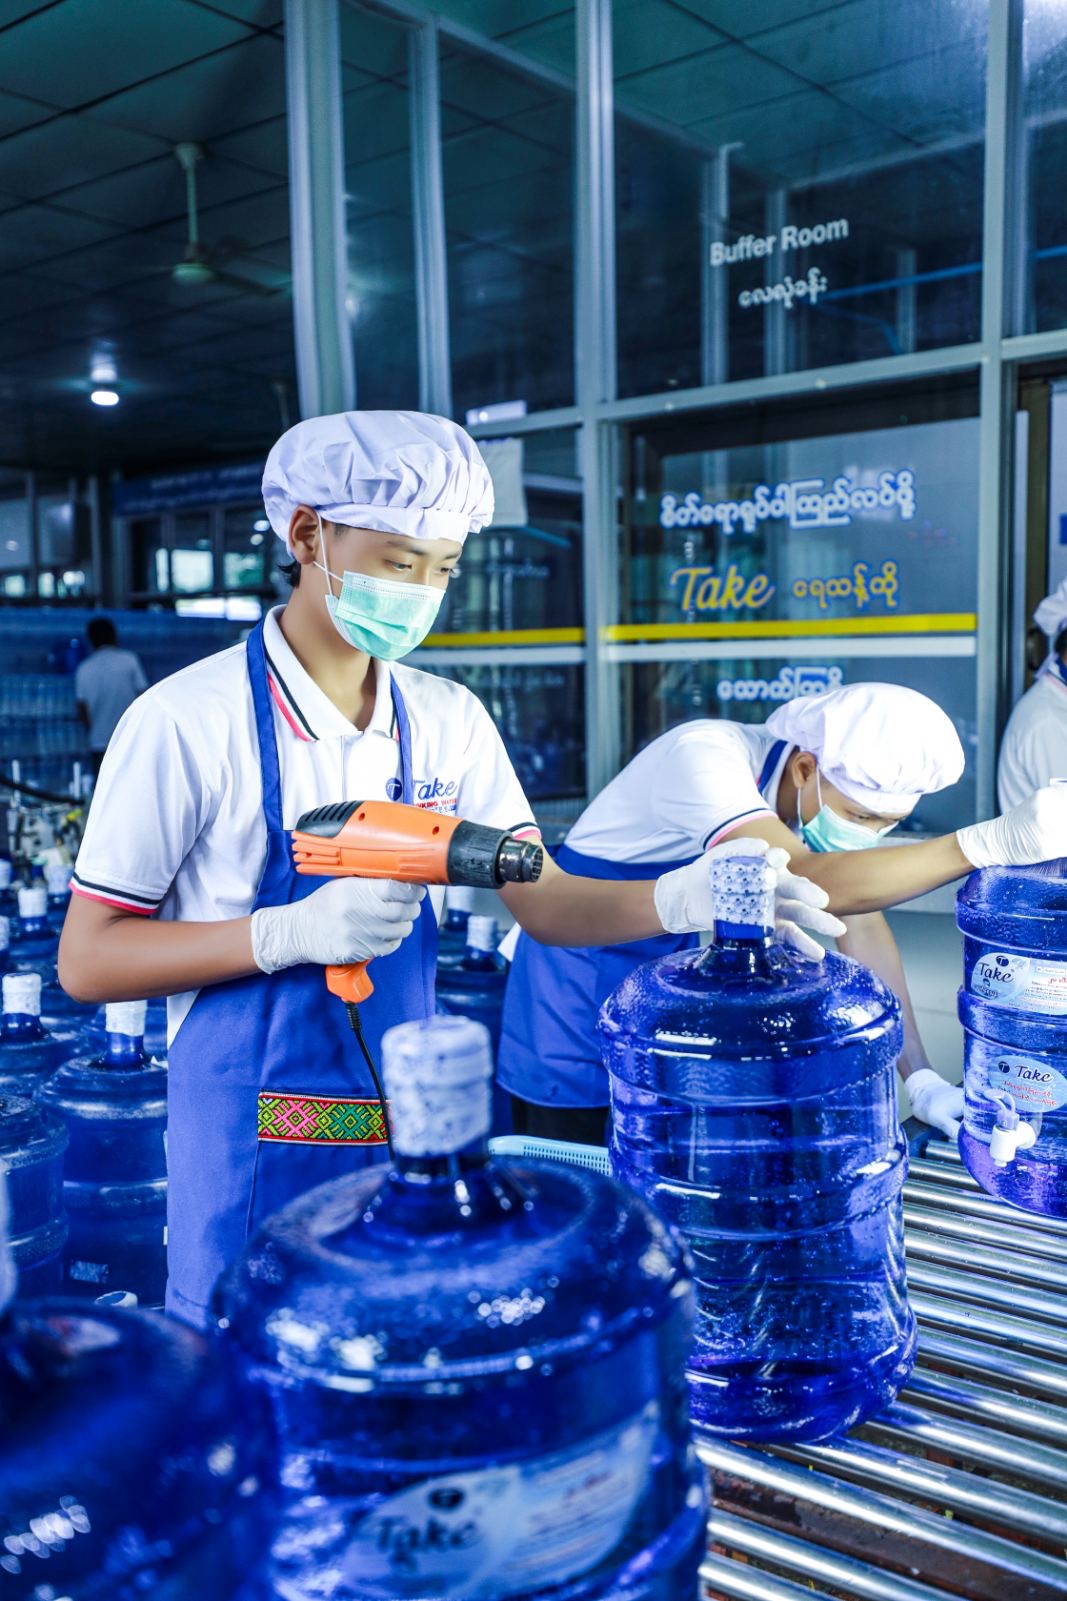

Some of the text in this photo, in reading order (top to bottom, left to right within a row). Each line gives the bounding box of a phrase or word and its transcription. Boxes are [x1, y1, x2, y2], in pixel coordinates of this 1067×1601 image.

[710, 218, 849, 266] Buffer Room
[670, 565, 775, 612] Take
[978, 962, 1014, 983] Take
[1015, 1065, 1053, 1083] Take
[374, 1515, 482, 1553] Take
